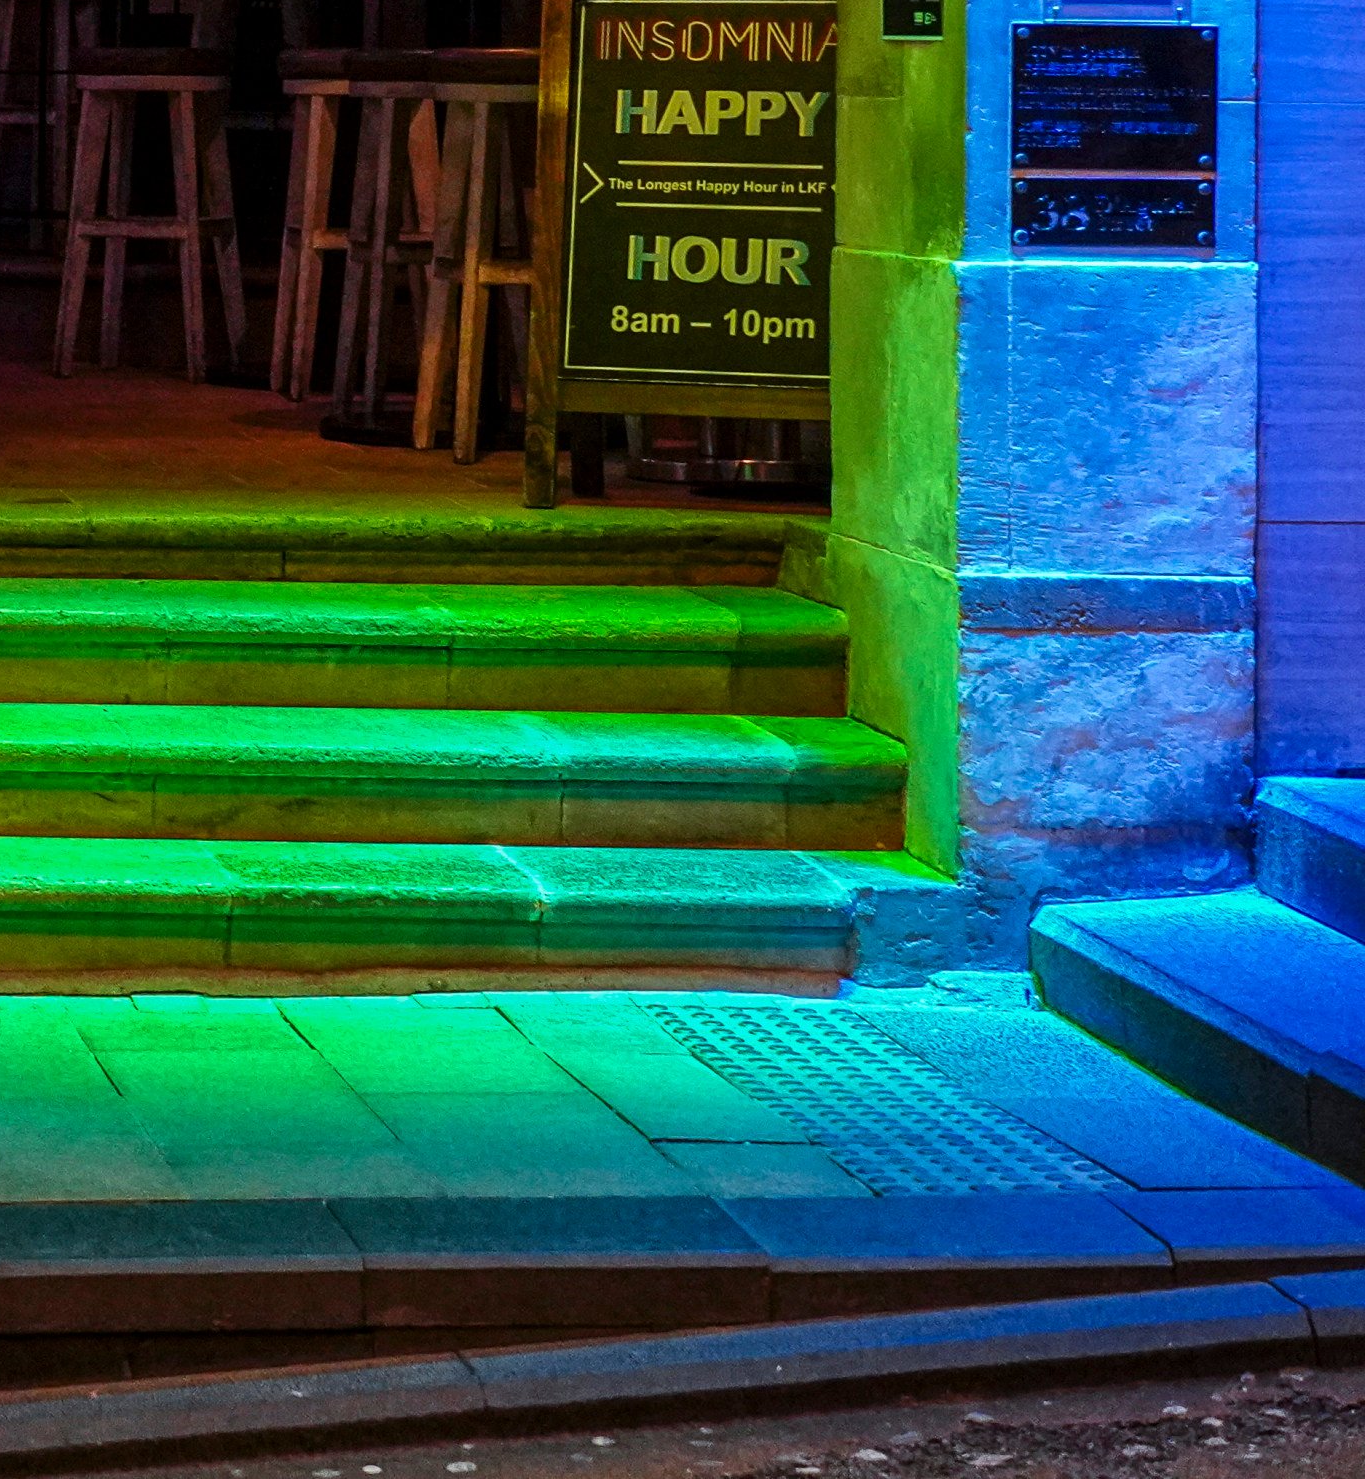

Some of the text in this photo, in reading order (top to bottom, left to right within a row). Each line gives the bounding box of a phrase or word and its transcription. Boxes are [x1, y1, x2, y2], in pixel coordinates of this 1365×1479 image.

[615, 89, 830, 137] HAPPY
[609, 177, 827, 195] The Longest Happy Hour in LKF
[627, 234, 811, 286] HOUR
[611, 305, 680, 334] 8am
[724, 308, 816, 344] 10pm
